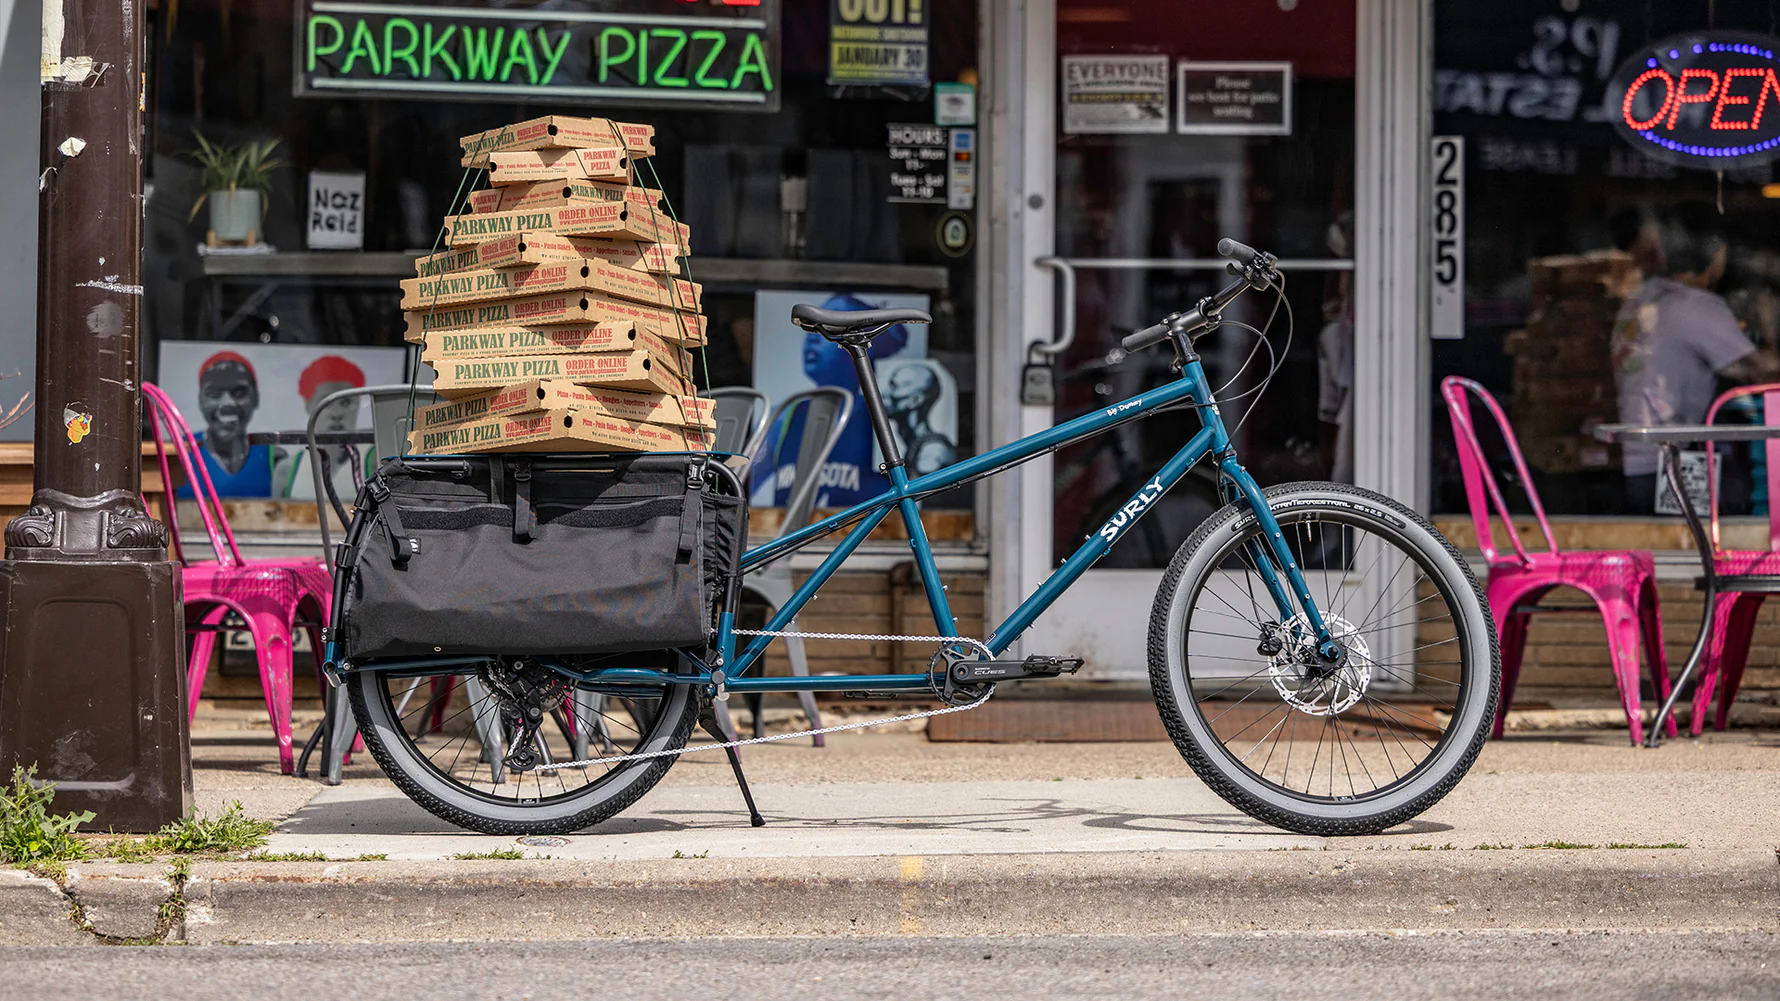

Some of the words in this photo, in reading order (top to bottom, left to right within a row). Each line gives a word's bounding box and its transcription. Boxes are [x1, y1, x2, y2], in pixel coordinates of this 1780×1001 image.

[307, 15, 572, 85] PARKWAY
[600, 27, 774, 91] PIZZA
[838, 46, 898, 65] JANUARY
[904, 48, 921, 67] 30
[1068, 62, 1165, 80] EVERYONE
[1623, 68, 1780, 131] OPEN
[622, 126, 647, 136] PARKWAY
[583, 150, 617, 160] PARKWAY
[590, 161, 611, 171] PIZZA
[571, 184, 604, 199] PARKWAY
[604, 189, 624, 201] PIZZA
[558, 208, 587, 221] ORDER
[588, 205, 617, 218] ONLINE
[1435, 141, 1458, 286] 285
[453, 216, 513, 236] PARKWAY
[517, 213, 553, 231] PIZZA
[457, 249, 479, 269] PIZZA
[513, 269, 540, 282] ORDER
[541, 266, 568, 279] ONLINE
[419, 276, 474, 298] PARKWAY
[477, 272, 509, 290] PIZZA
[514, 302, 540, 314] ORDER
[541, 298, 567, 311] ONLINE
[422, 308, 475, 330] PARKWAY
[478, 304, 510, 323] PIZZA
[442, 333, 506, 351] PARKWAY
[509, 331, 546, 348] PIZZA
[551, 329, 581, 341] ORDER
[583, 328, 613, 339] ONLINE
[455, 362, 519, 380] PARKWAY
[522, 360, 560, 377] PIZZA
[565, 359, 595, 371] ORDER
[597, 357, 627, 368] ONLINE
[490, 393, 508, 406] ORDER
[509, 388, 527, 401] ONLINE
[556, 390, 569, 399] Pizza
[572, 392, 585, 400] Pasta
[425, 403, 464, 426] PARKWAY
[465, 397, 487, 417] PIZZA
[1106, 407, 1118, 417] Big
[1118, 399, 1143, 412] Dummy
[505, 420, 527, 433] ORDER
[529, 416, 552, 429] ONLINE
[582, 418, 593, 426] Pizza
[595, 420, 606, 428] Pasta
[423, 427, 471, 450] PARKWAY
[473, 423, 501, 442] PIZZA
[1100, 475, 1164, 542] SURLY
[1234, 514, 1259, 530] SURL
